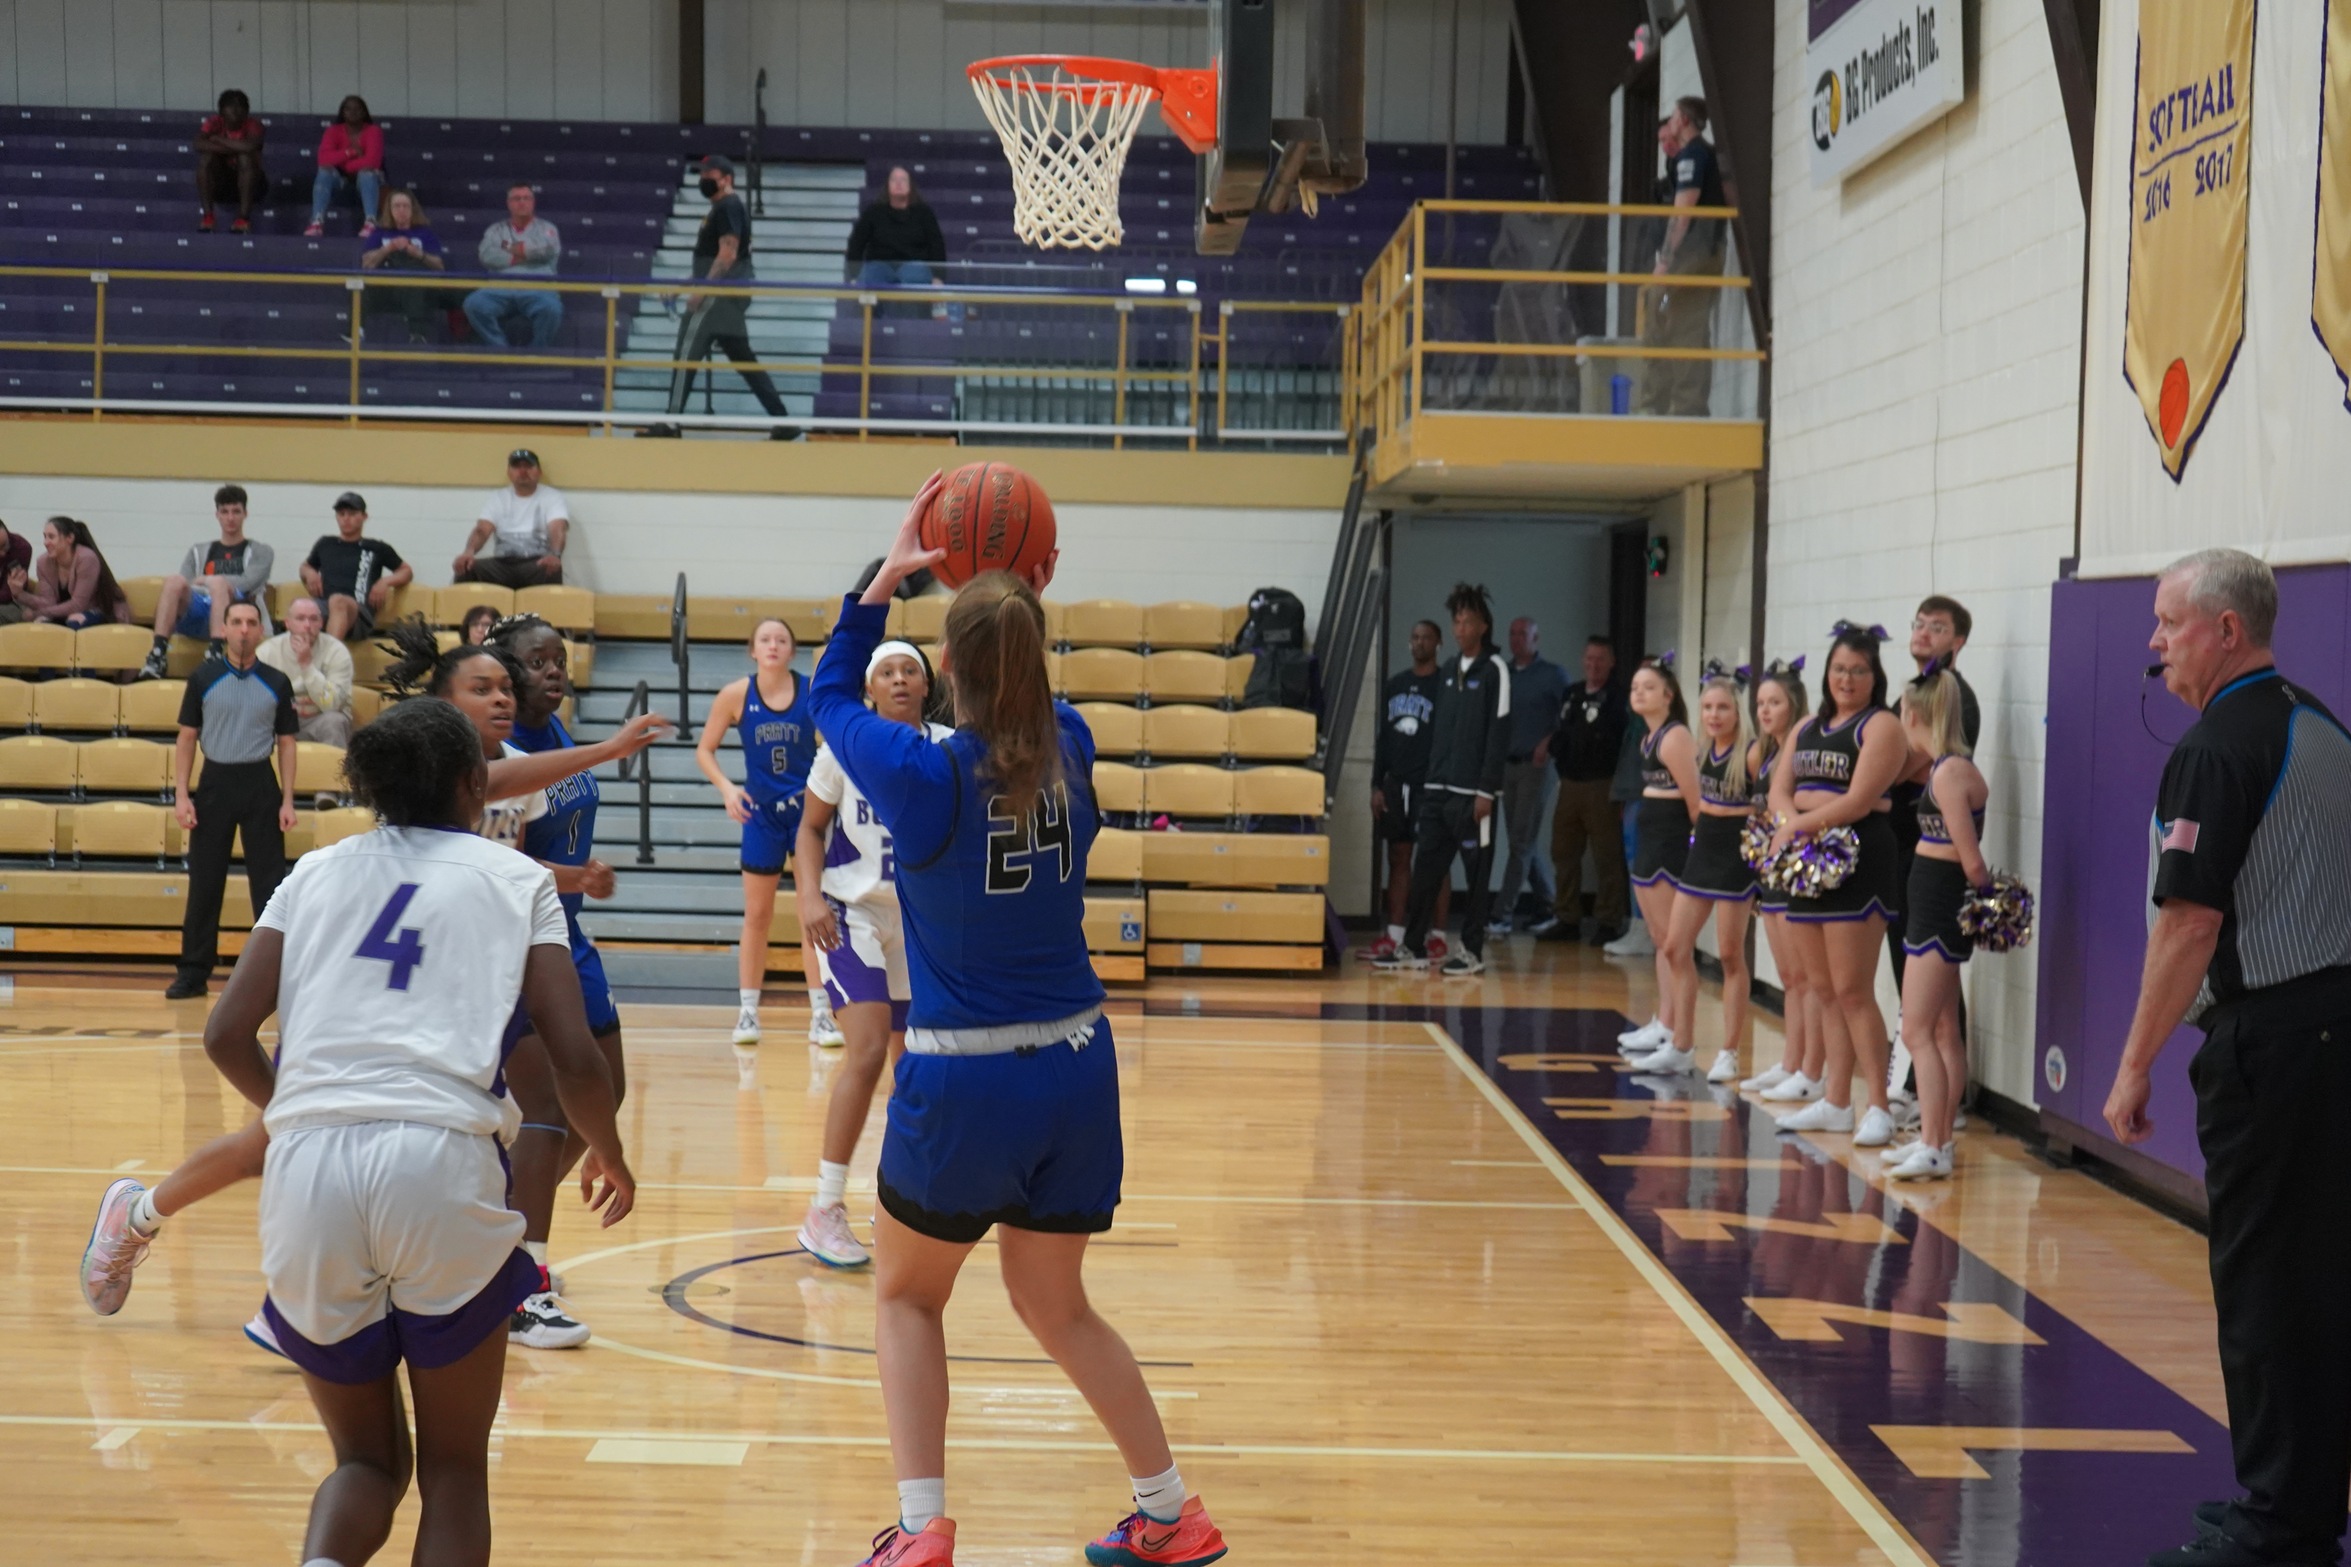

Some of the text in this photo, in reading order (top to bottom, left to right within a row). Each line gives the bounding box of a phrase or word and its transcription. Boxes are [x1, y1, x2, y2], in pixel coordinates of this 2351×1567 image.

[1845, 5, 1939, 125] BG Products, Inc.
[2195, 143, 2233, 197] 2017
[755, 722, 801, 745] PRATT
[772, 746, 788, 774] 5
[545, 768, 597, 816] PRATT
[568, 809, 581, 855] 1
[985, 779, 1072, 895] 24
[350, 881, 427, 993] 4
